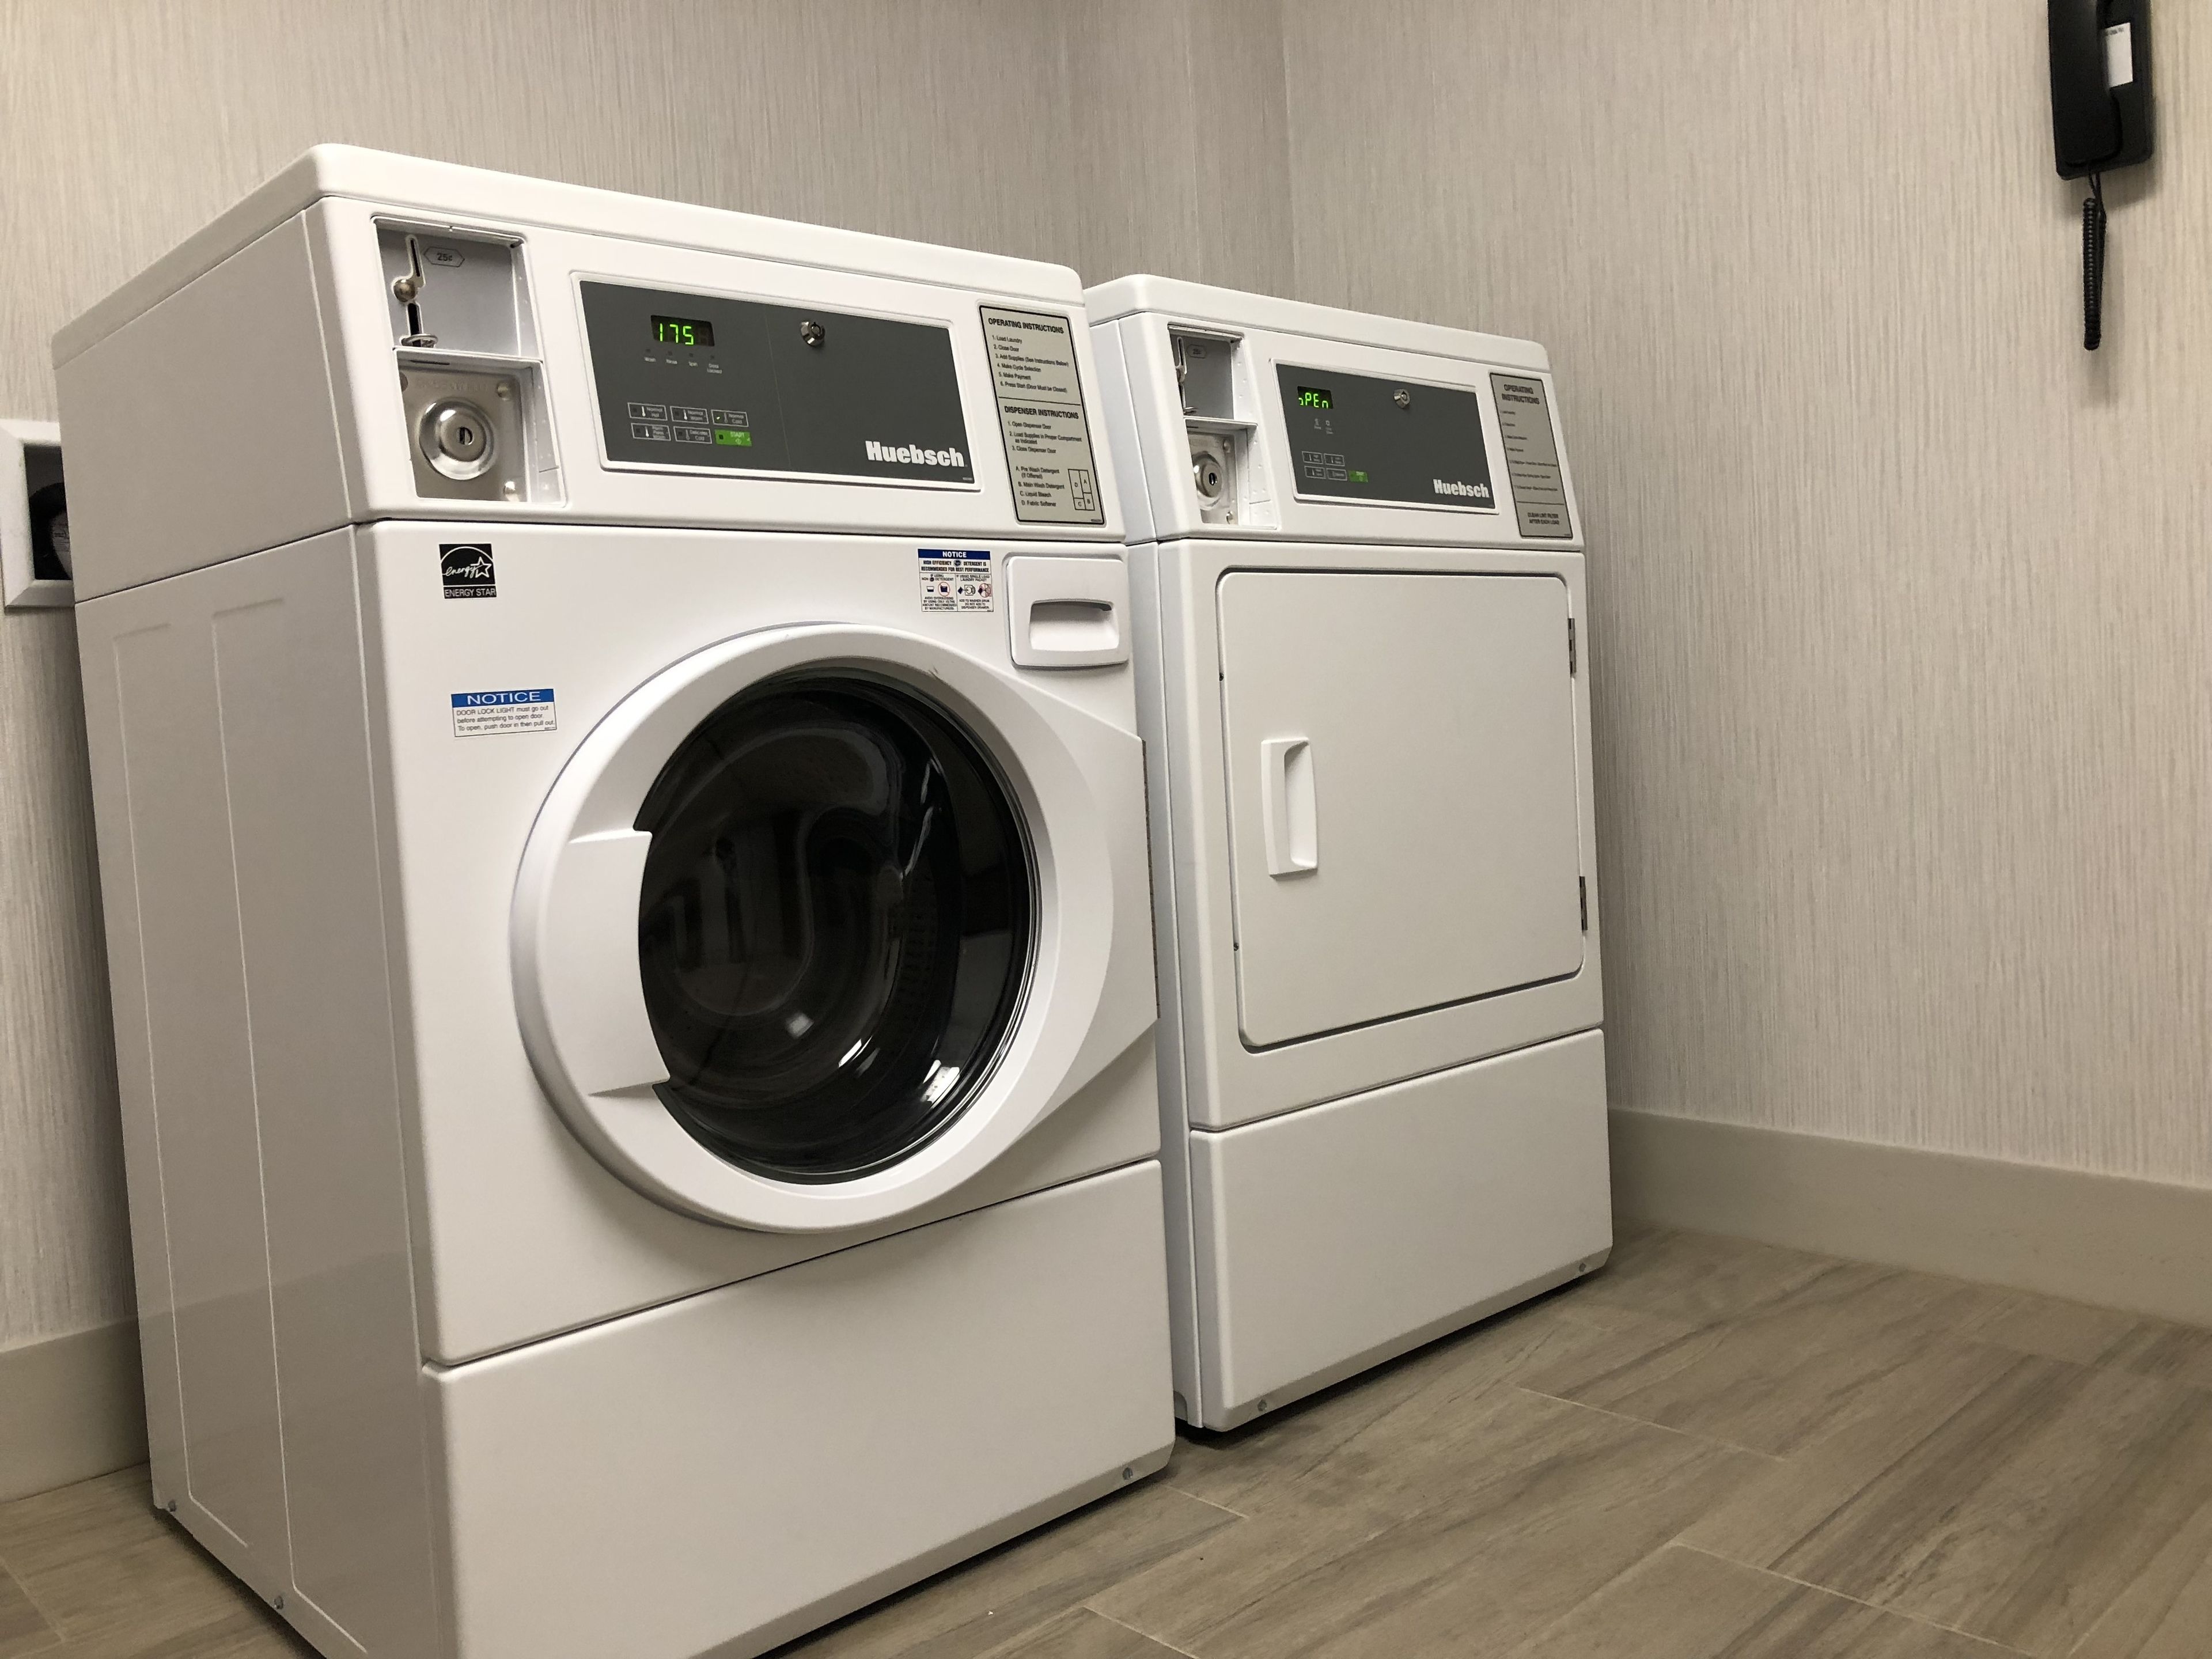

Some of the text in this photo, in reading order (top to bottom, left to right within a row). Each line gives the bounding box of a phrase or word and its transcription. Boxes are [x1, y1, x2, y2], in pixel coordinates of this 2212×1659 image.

[988, 318, 1064, 334] OPERATING INSTRUCTIONS
[660, 323, 694, 345] 175
[1503, 384, 1533, 395] OPERATING
[1501, 393, 1540, 404] INSTRUCTIONS
[1004, 406, 1079, 419] DISPENSER INSTRUCTIONS
[865, 441, 964, 467] Huebsch
[1433, 479, 1489, 498] Huebsch
[445, 589, 474, 597] ENERGY
[467, 692, 541, 704] NOTICE
